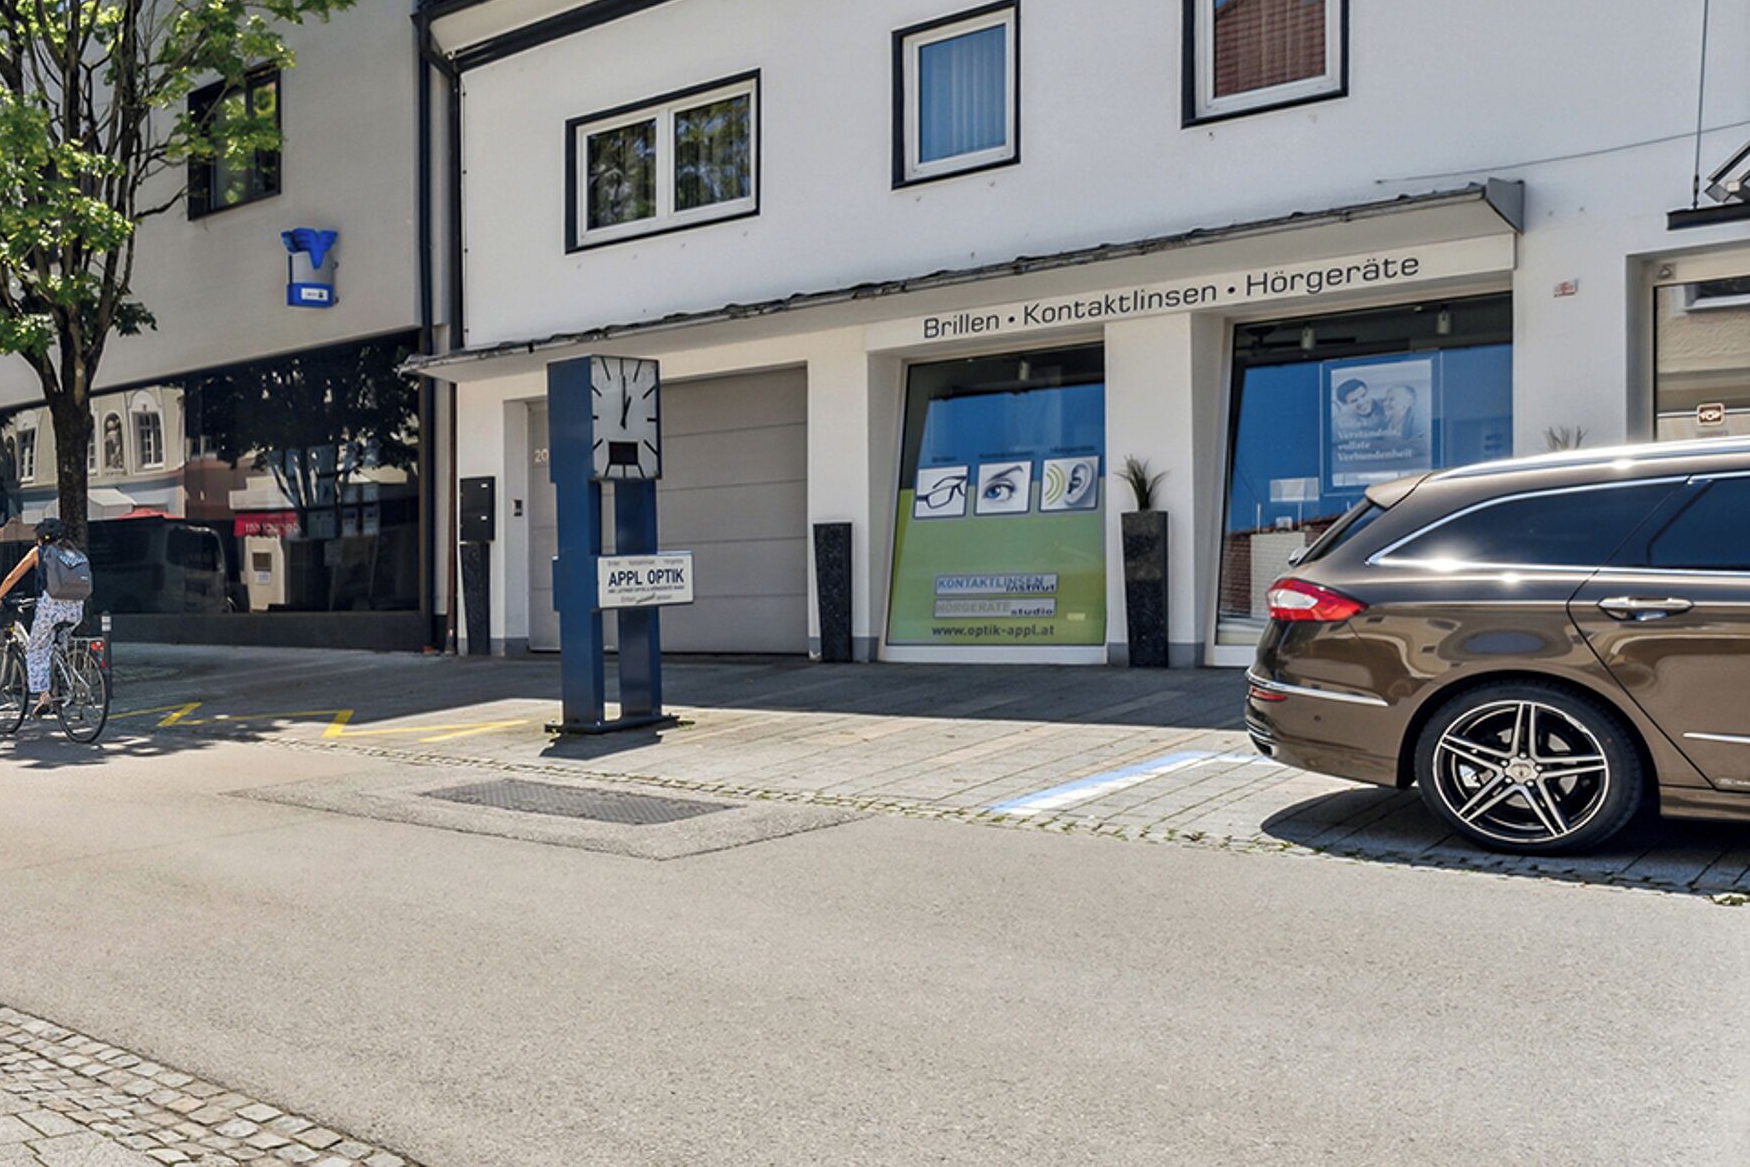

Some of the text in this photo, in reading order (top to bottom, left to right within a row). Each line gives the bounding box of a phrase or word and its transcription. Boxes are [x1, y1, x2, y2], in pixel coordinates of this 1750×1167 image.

[924, 256, 1419, 339] Brillen Kontaktlinsen Hörgeräte
[534, 448, 549, 463] 20
[608, 568, 684, 587] APPL OPTIK
[937, 577, 1044, 589] KONTAKTLINSEN
[1011, 607, 1054, 616] studio
[932, 624, 1055, 637] www.optik-appl.at
